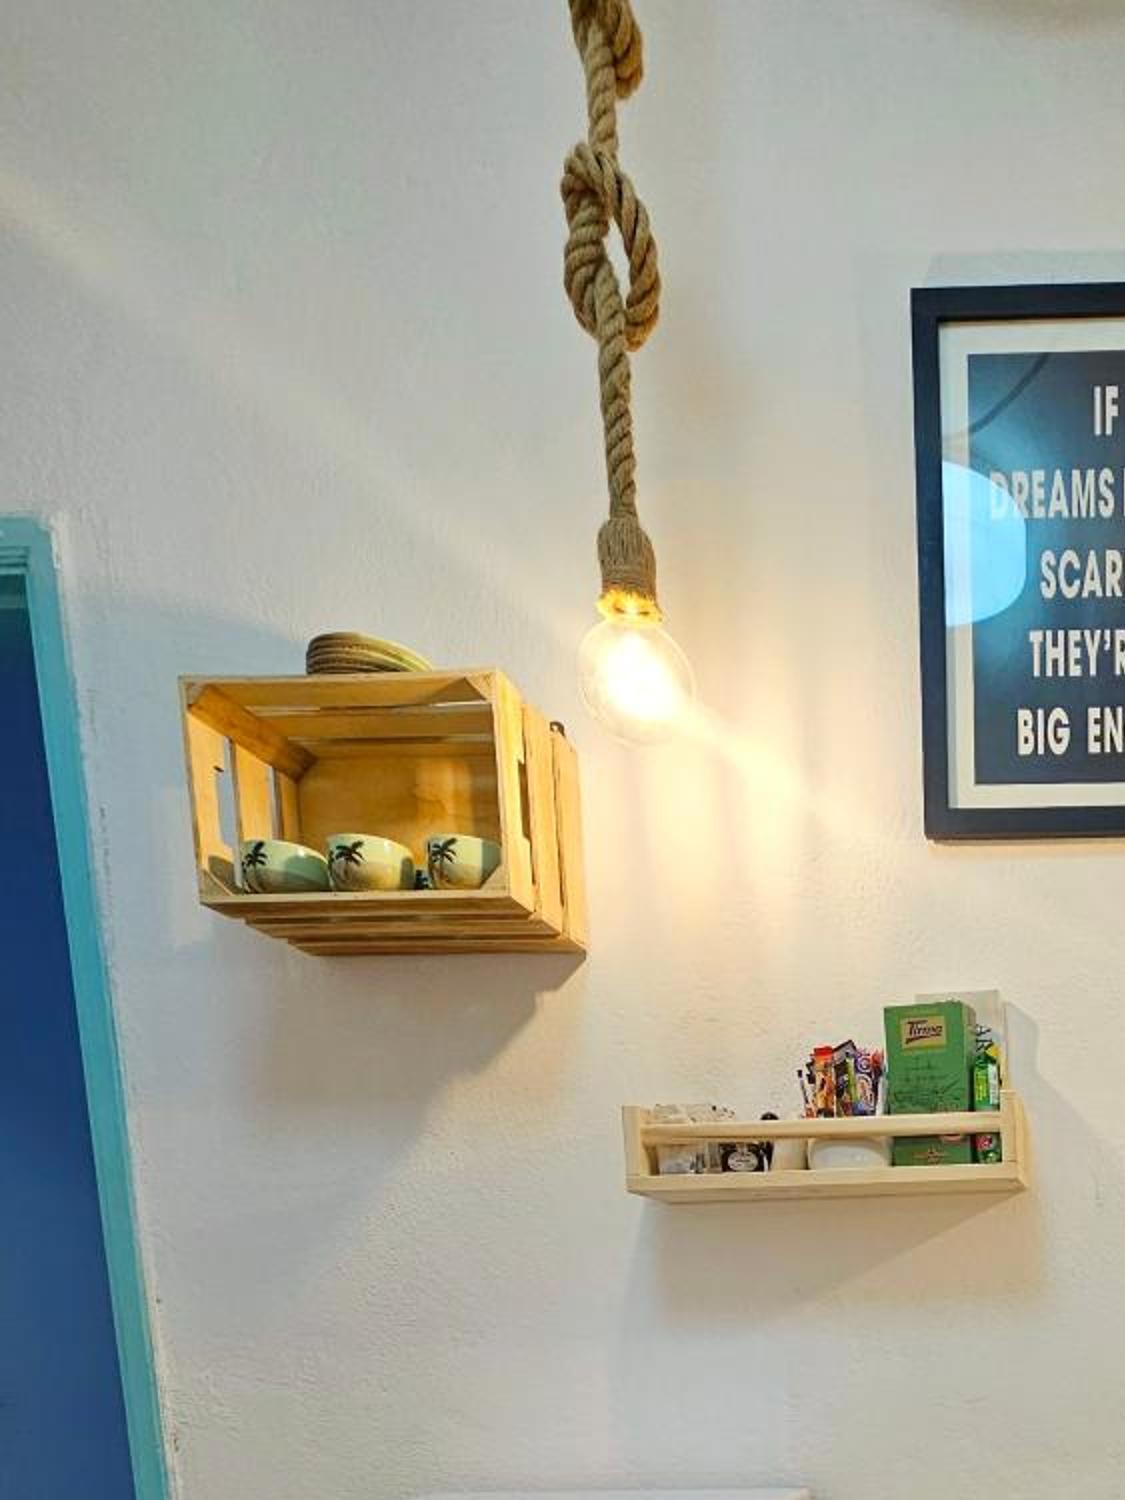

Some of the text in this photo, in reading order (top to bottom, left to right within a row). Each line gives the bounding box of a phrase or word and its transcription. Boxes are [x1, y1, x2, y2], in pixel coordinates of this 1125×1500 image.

[1093, 385, 1119, 436] IF
[989, 467, 1115, 519] DREAMS
[1017, 706, 1072, 756] BIG
